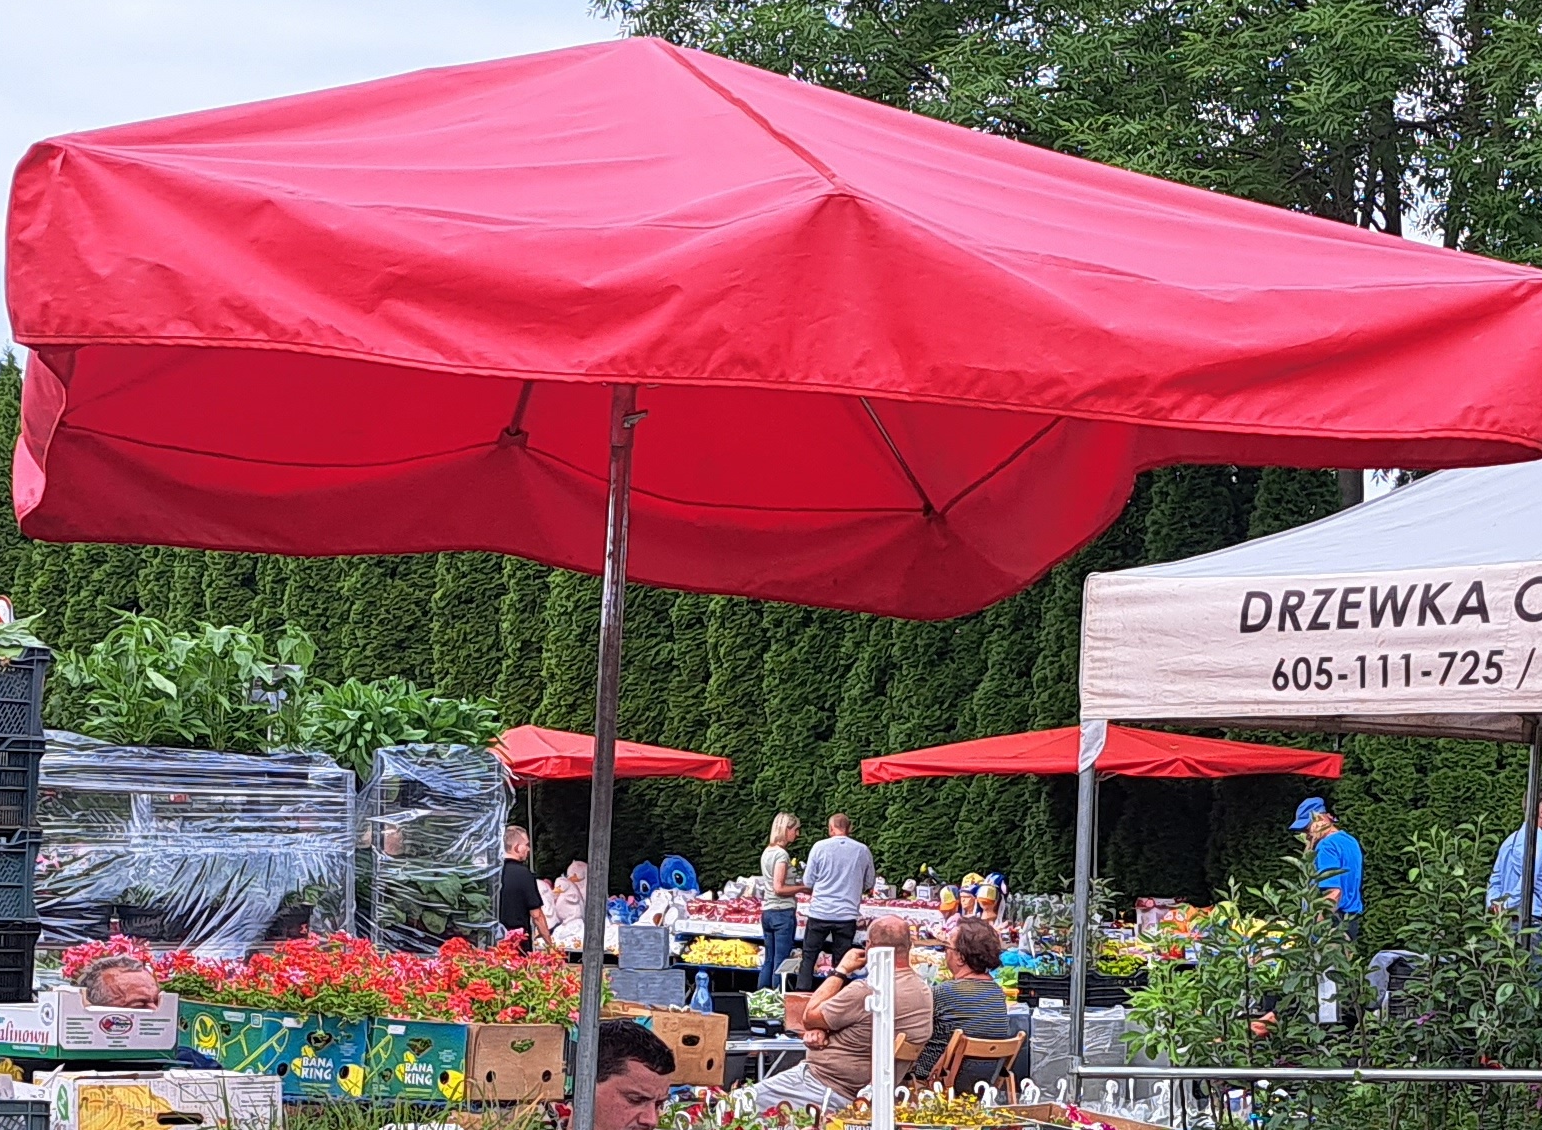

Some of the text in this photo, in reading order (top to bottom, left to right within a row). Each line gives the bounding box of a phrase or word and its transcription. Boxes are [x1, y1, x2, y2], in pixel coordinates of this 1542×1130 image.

[1239, 580, 1490, 634] DRZEWKA
[1271, 648, 1505, 692] 605-111-725
[1515, 646, 1537, 690] /
[302, 1056, 334, 1070] BANA
[404, 1062, 434, 1075] BANA
[300, 1066, 332, 1081] KING
[404, 1072, 433, 1085] KING
